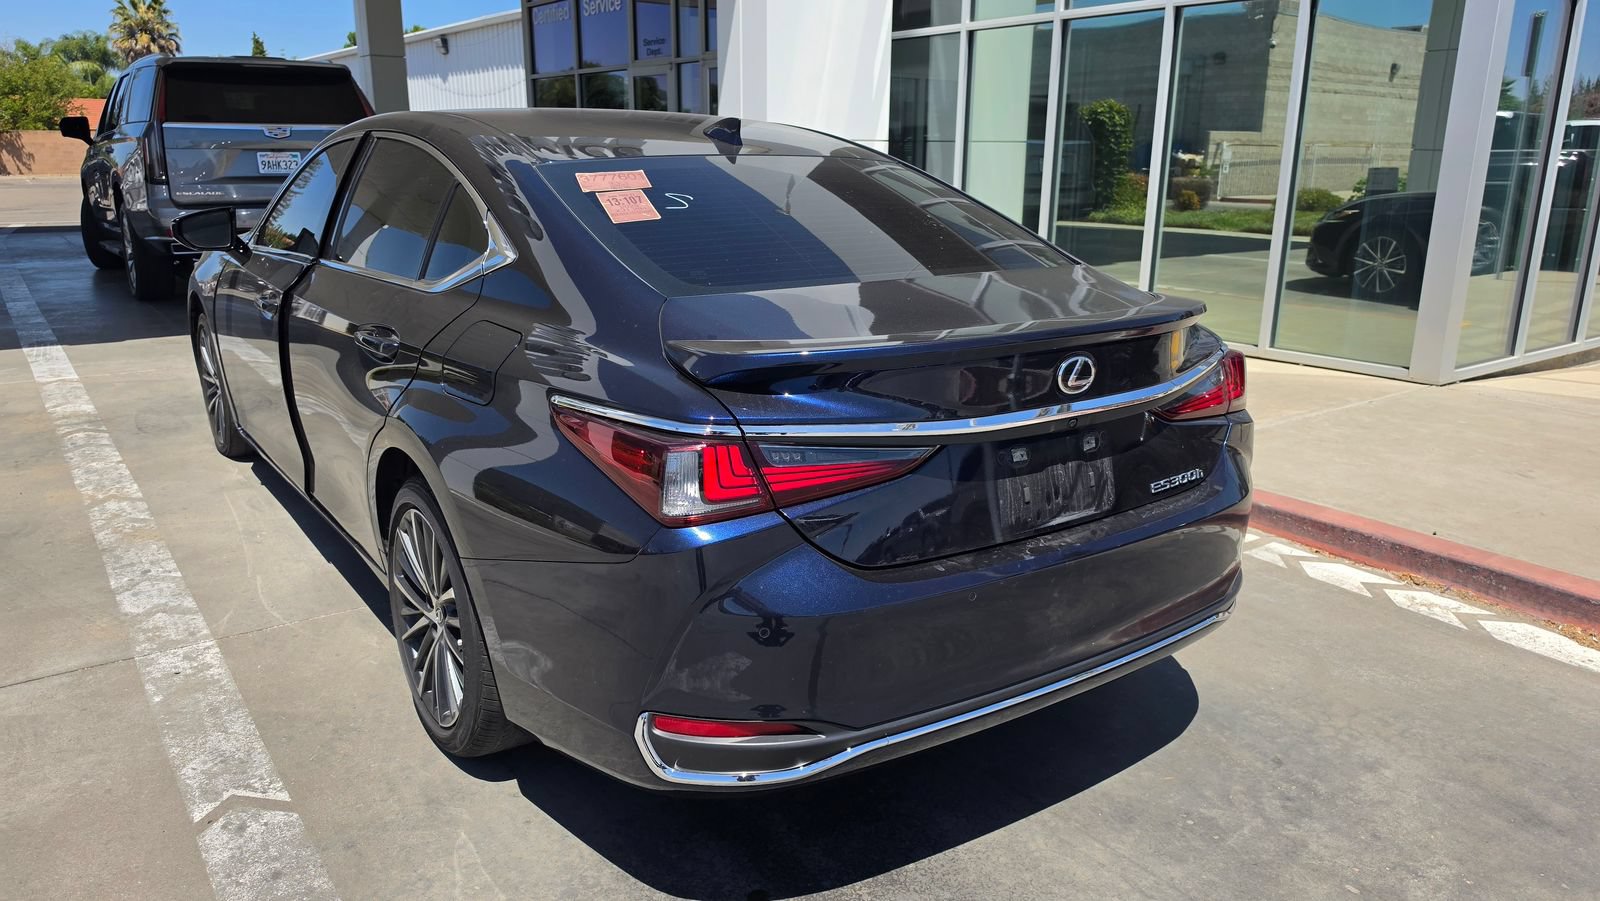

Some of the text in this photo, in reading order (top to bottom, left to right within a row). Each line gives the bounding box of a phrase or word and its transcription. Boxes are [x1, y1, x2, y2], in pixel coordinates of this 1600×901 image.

[583, 0, 621, 16] Service
[643, 37, 665, 47] Service
[1150, 468, 1204, 494] ES300h
